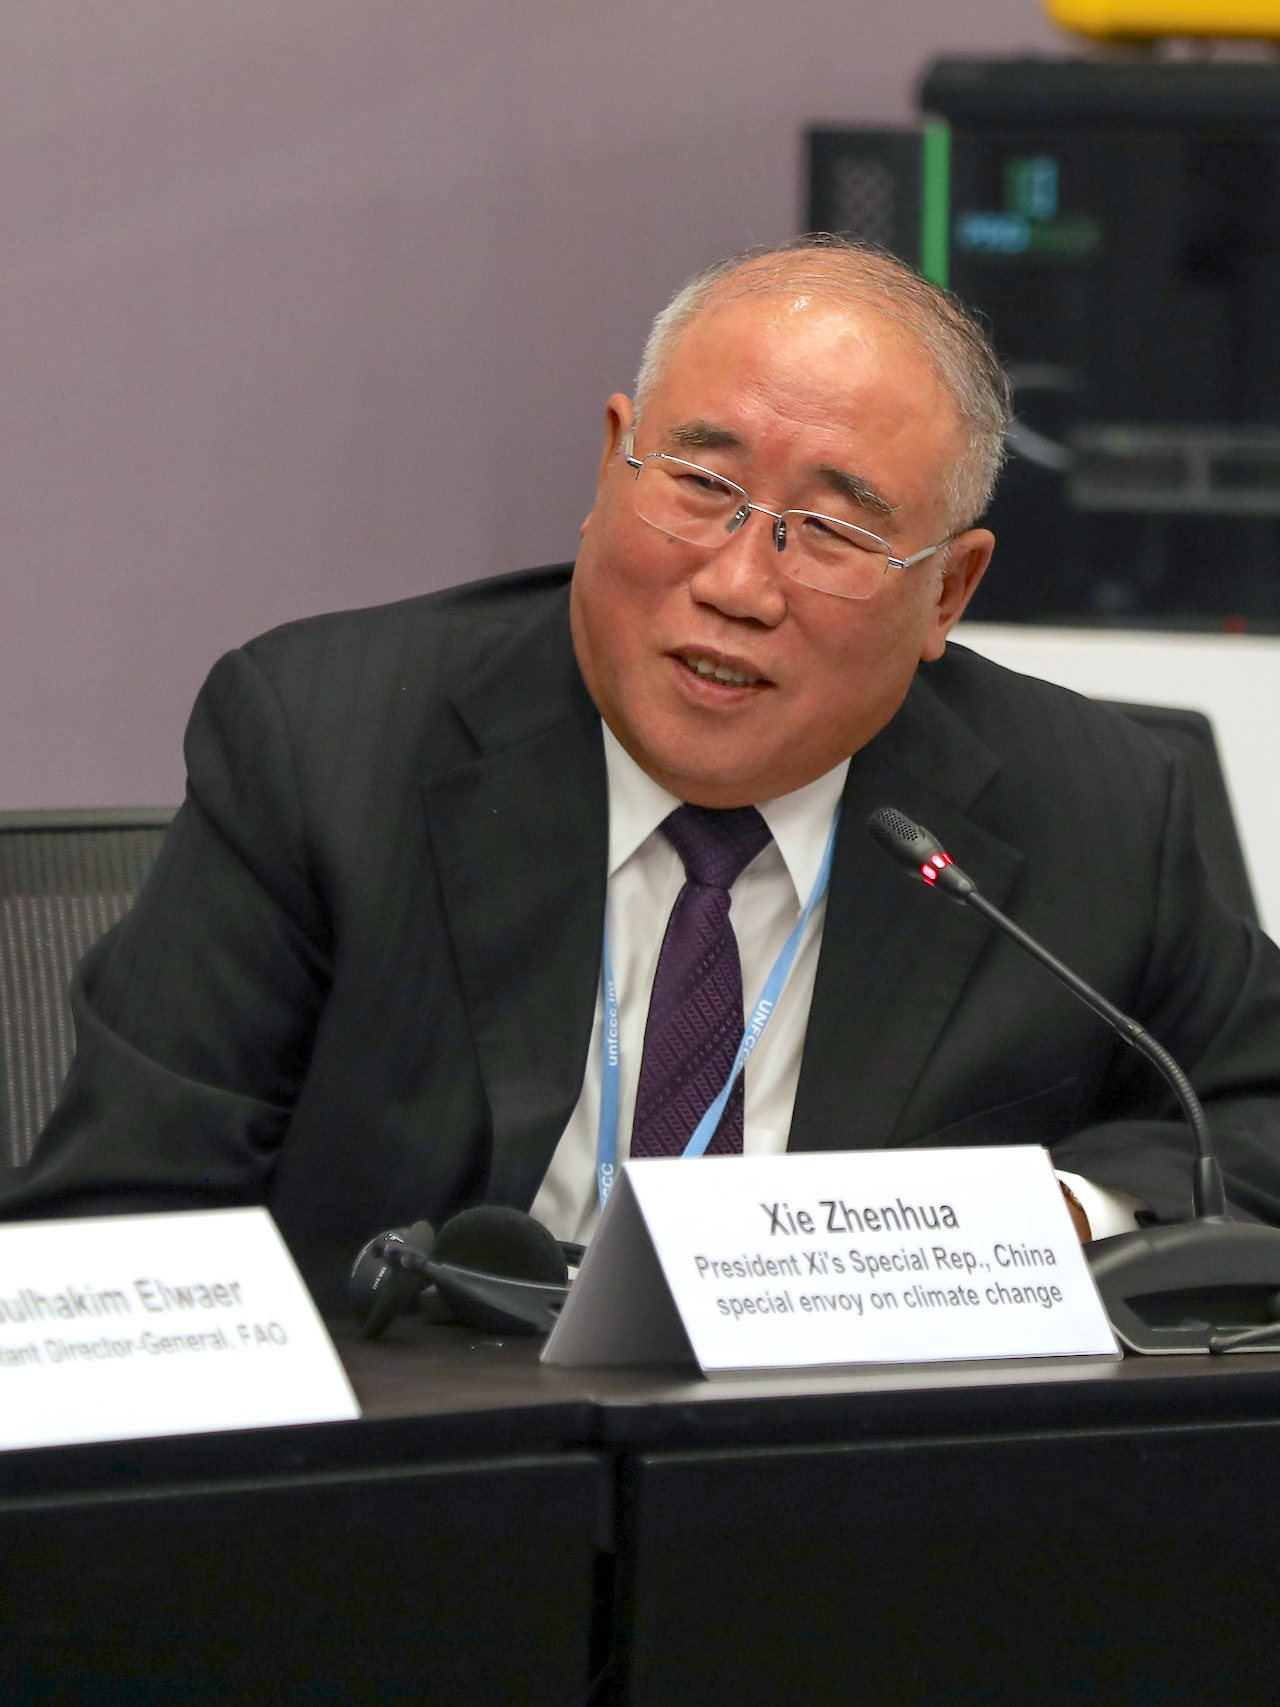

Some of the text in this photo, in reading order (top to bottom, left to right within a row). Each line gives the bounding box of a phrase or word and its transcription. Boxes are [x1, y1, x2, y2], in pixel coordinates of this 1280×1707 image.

[607, 981, 619, 1067] unfccc.int
[758, 1198, 961, 1237] Xie Zhenhua
[694, 1242, 1058, 1280] President Xi's Special Rep., China
[0, 1278, 243, 1324] ulhakim Elwaer
[716, 1282, 1064, 1321] special envoy on climate change
[235, 1320, 289, 1348] FAO
